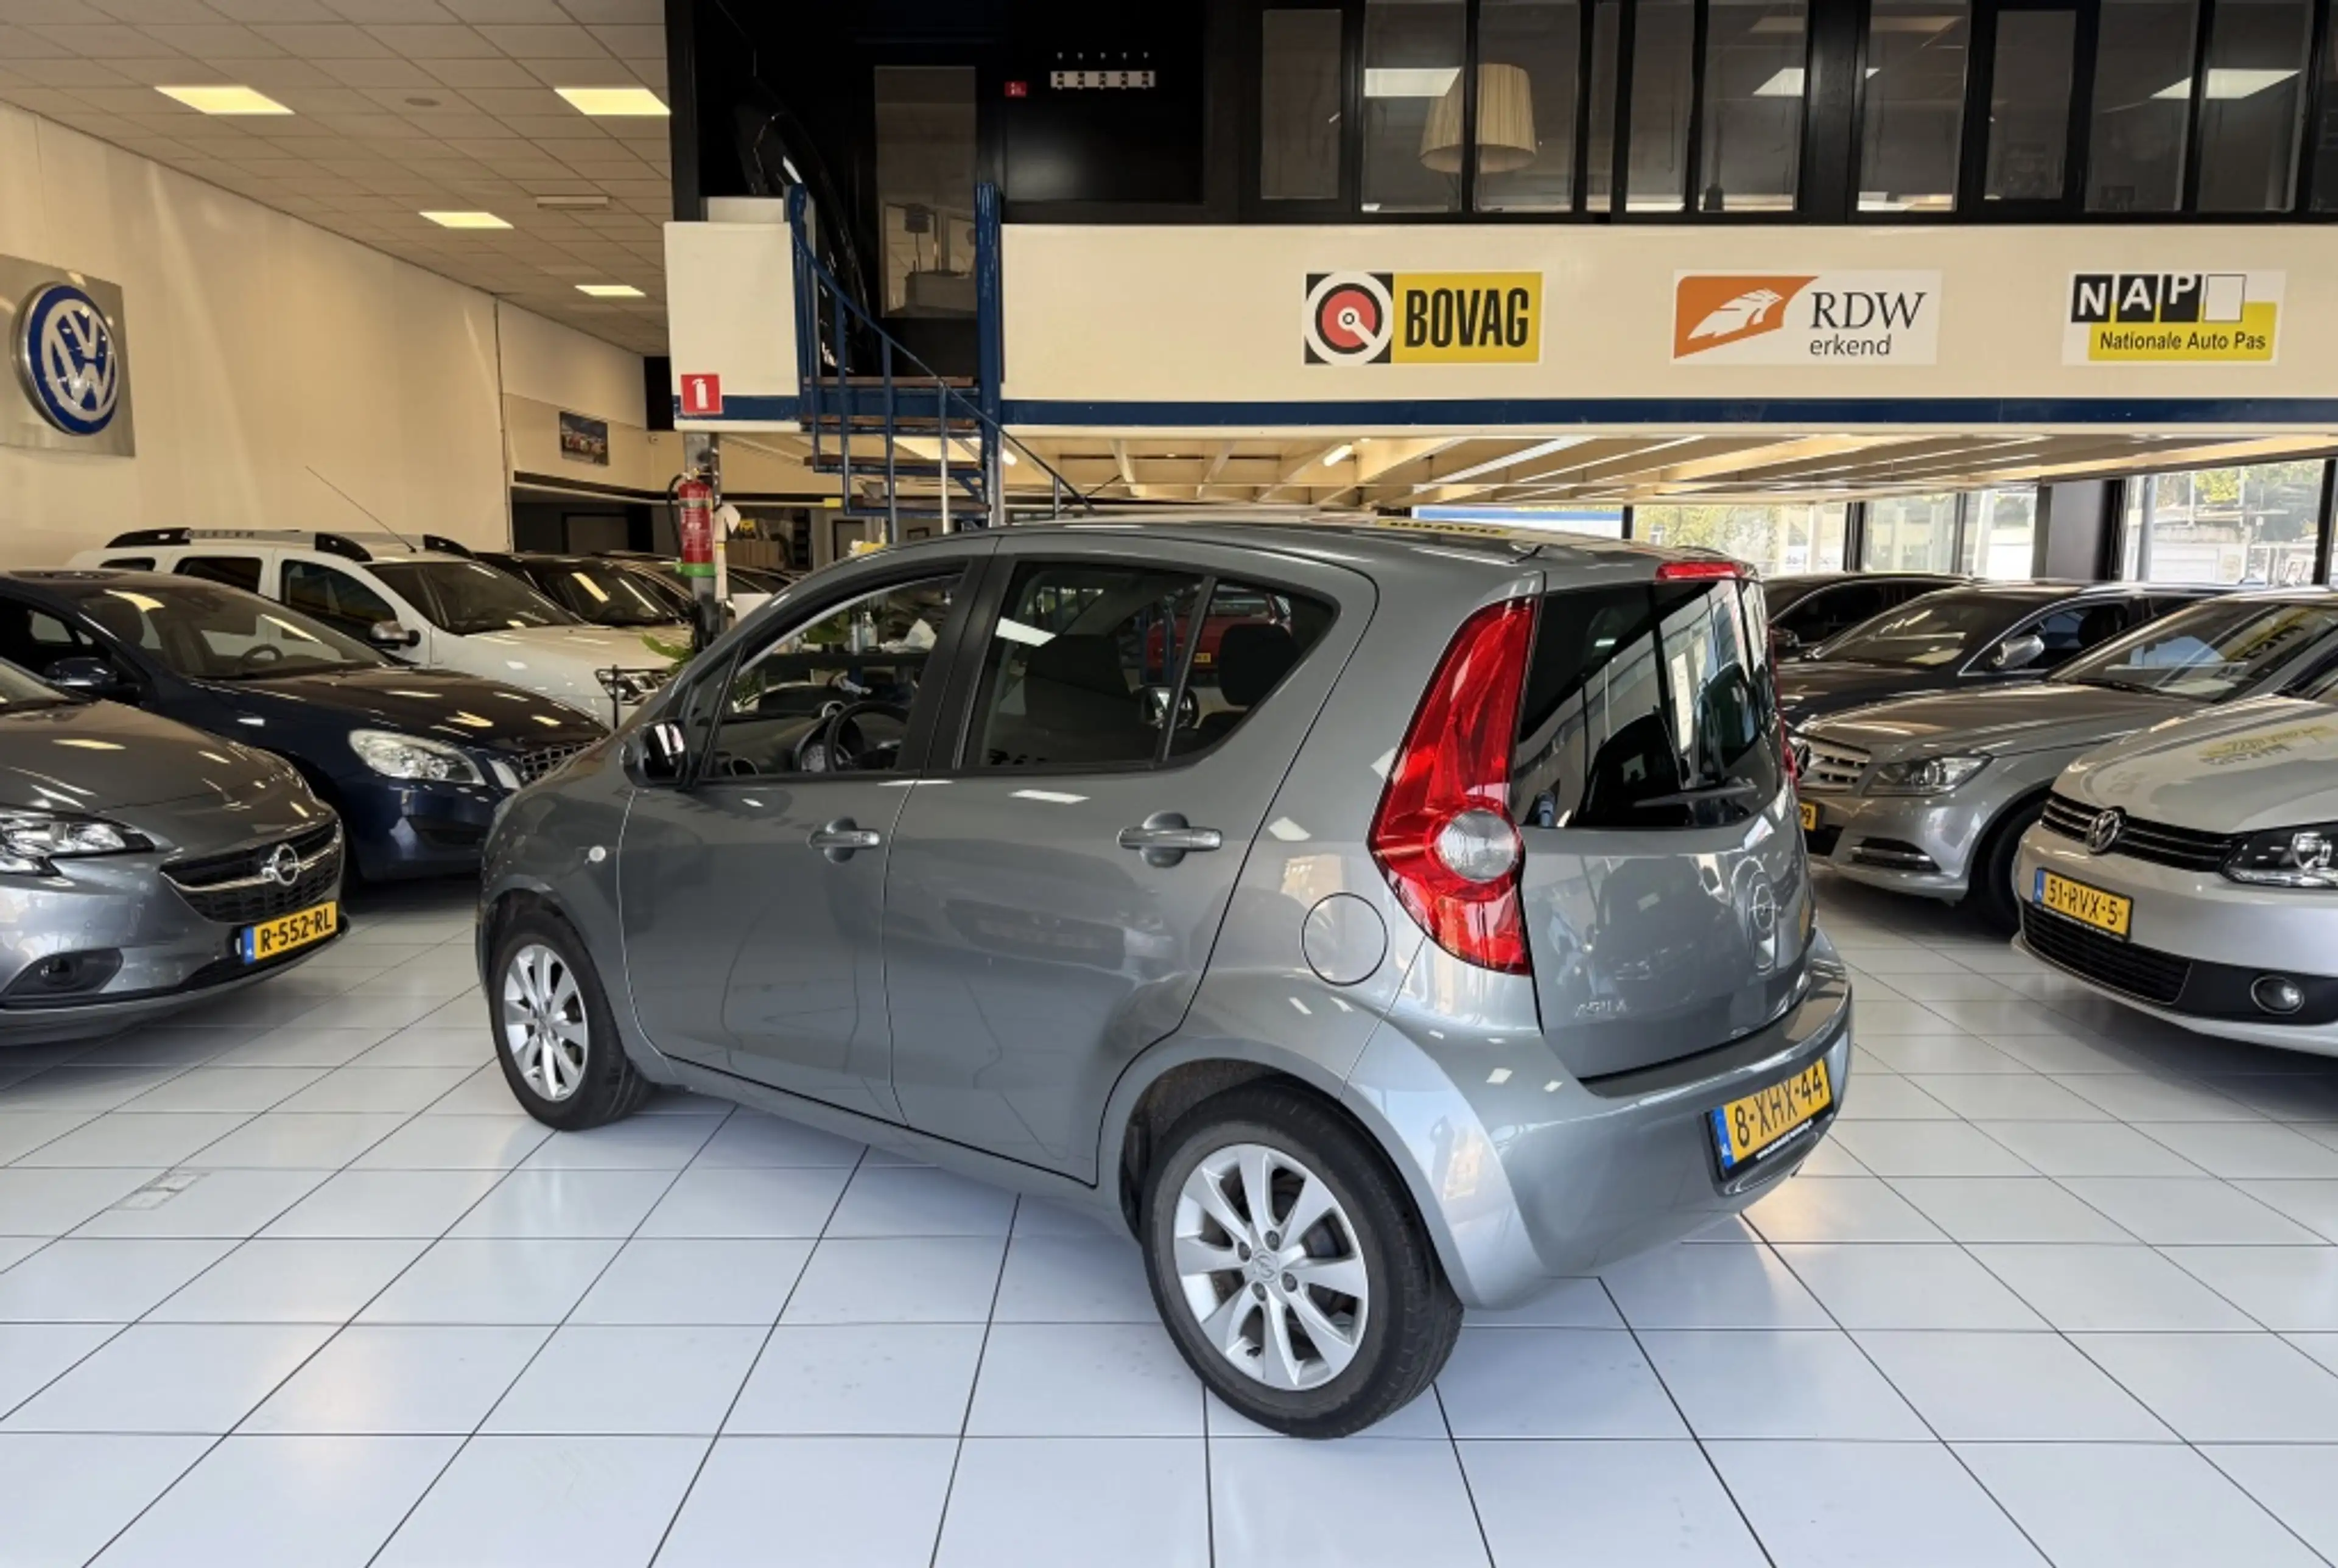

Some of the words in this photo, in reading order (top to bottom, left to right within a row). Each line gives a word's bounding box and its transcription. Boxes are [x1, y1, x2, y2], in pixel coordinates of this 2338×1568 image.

[1809, 292, 1928, 329] RDW
[2077, 275, 2196, 316] NAP
[1405, 287, 1529, 348] BOVAG
[1810, 334, 1891, 355] erkend
[2100, 331, 2182, 351] Nationale
[2186, 332, 2229, 350] Auto
[2233, 332, 2266, 350] Pas
[2048, 878, 2118, 925] 51-RVX-5
[260, 908, 332, 953] R-552-RL
[1735, 1065, 1824, 1147] 8-XHX-44
